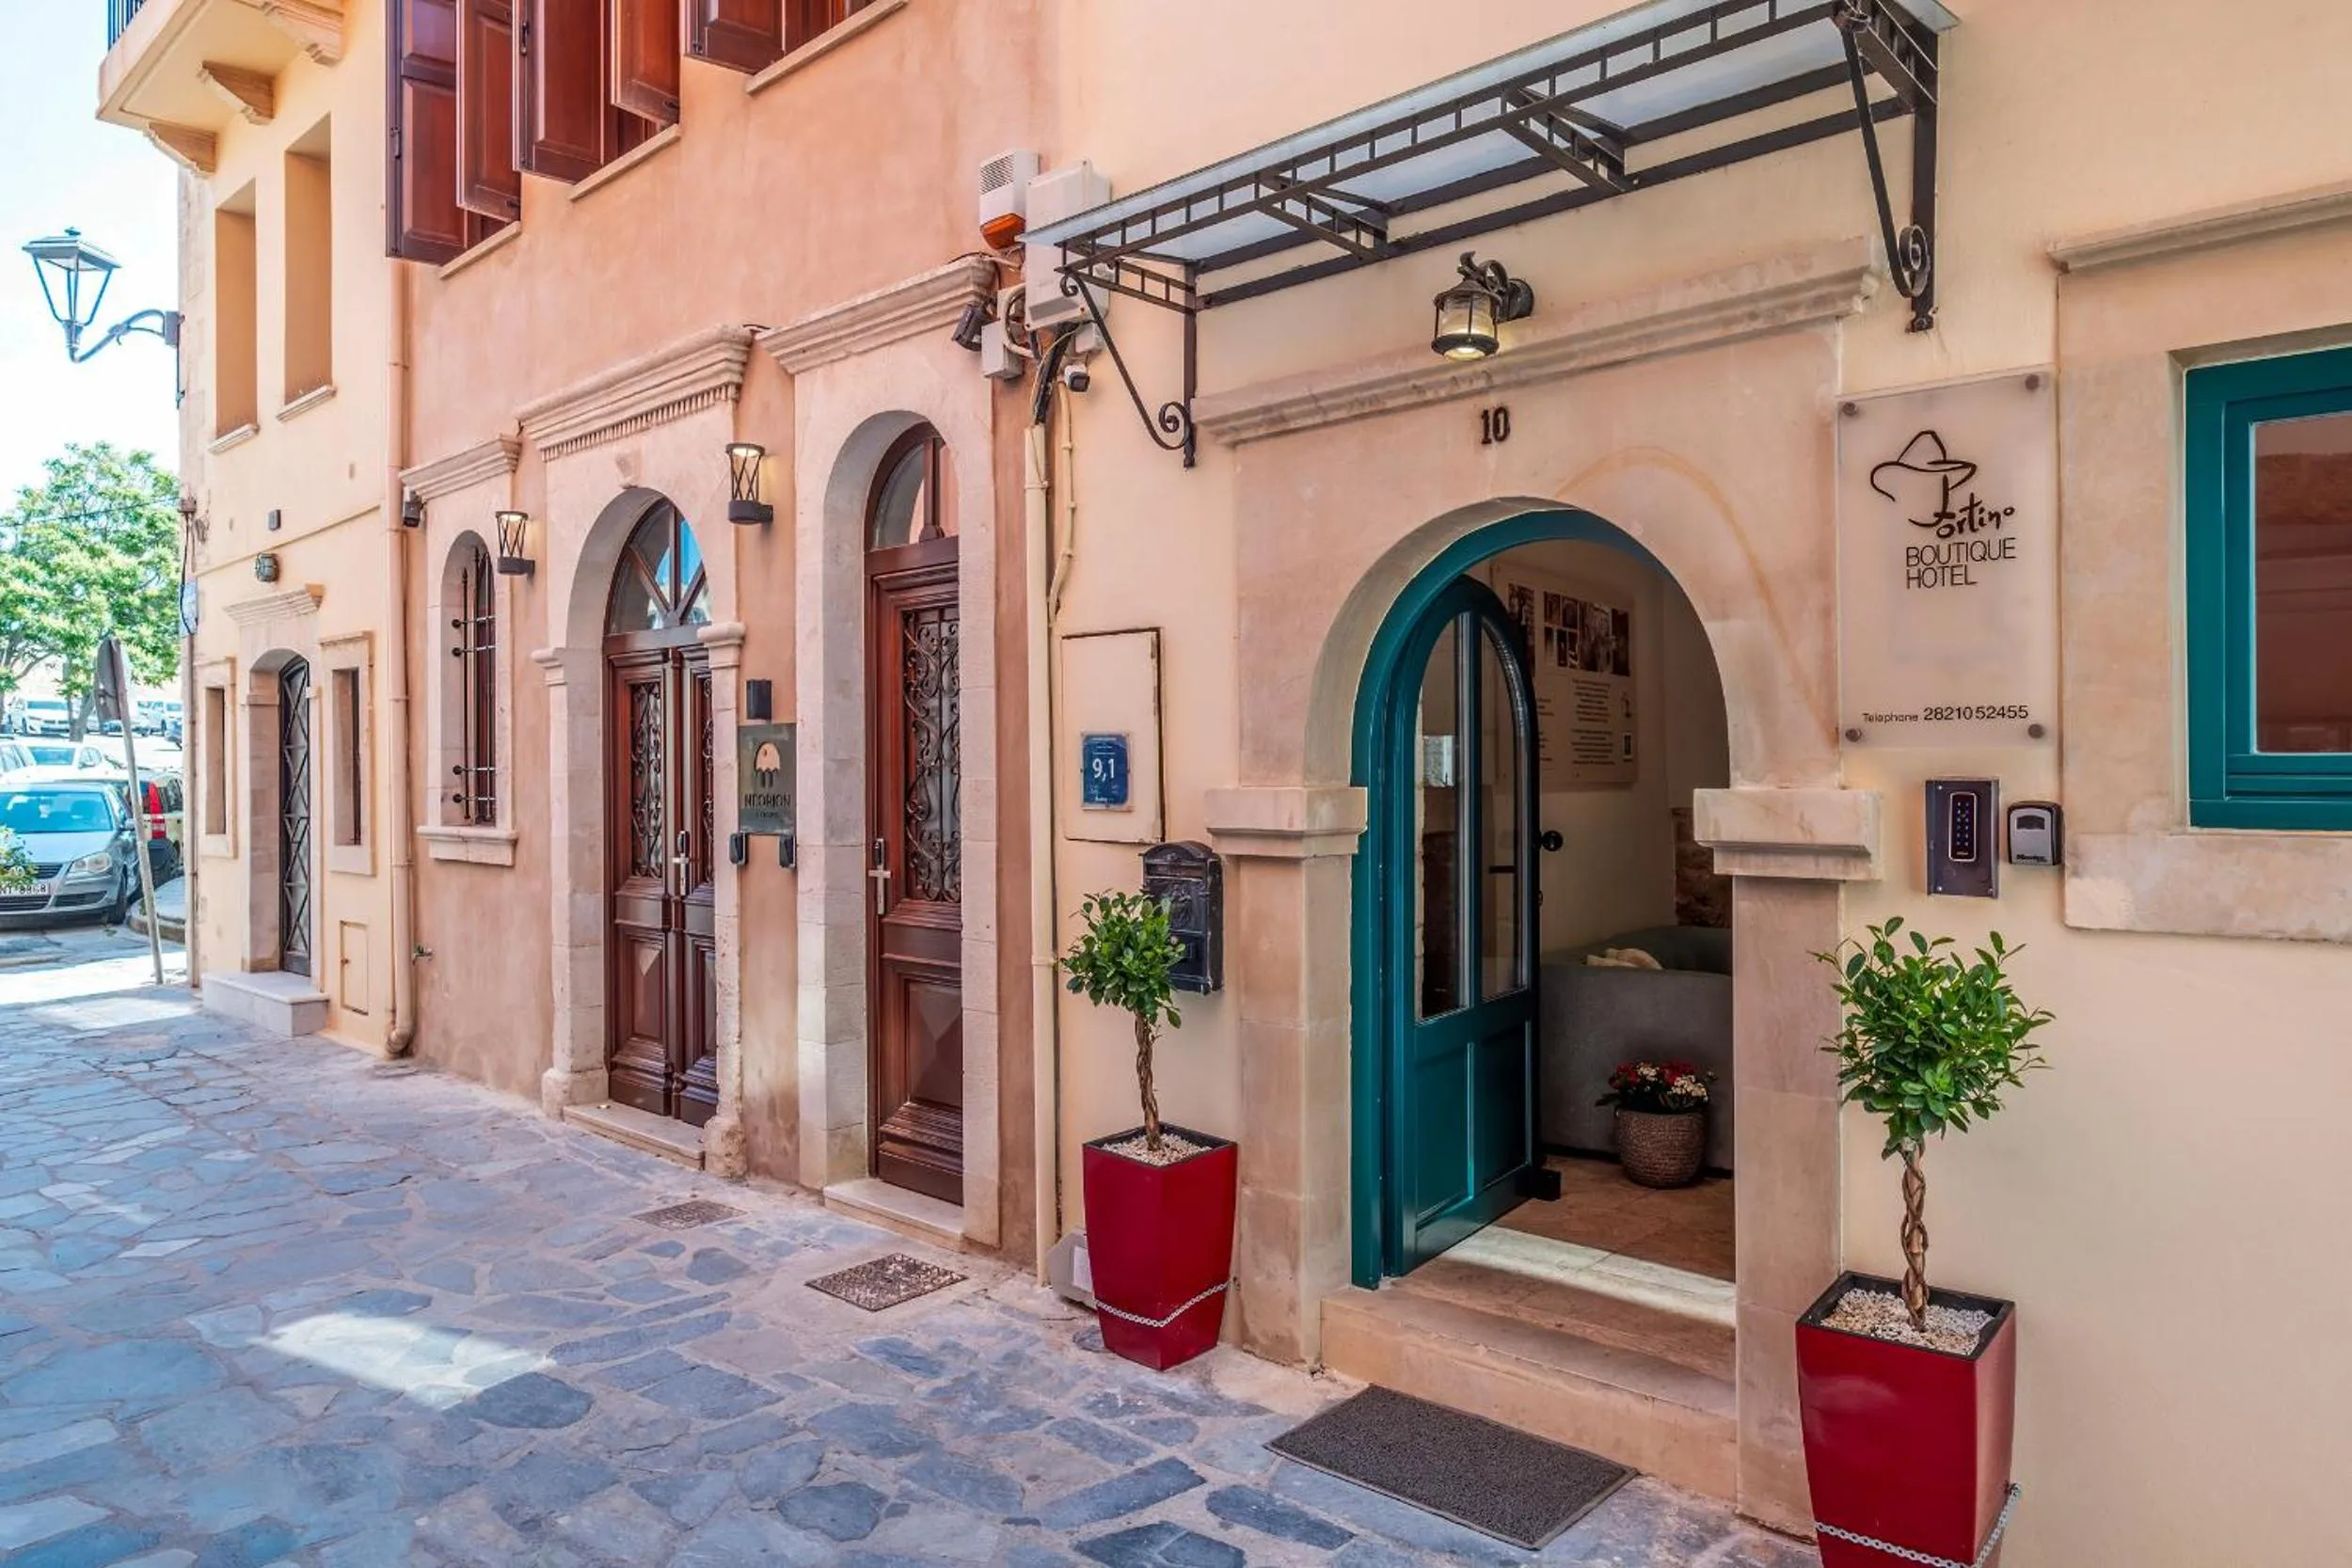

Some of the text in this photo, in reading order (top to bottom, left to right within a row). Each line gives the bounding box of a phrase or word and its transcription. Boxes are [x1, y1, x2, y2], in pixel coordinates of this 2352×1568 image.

[1481, 406, 1511, 444] 10
[1906, 537, 2017, 567] BOUTIQUE
[1906, 563, 1978, 590] HOTEL
[1863, 711, 1919, 723] Telephone
[1092, 758, 1115, 783] 9,1
